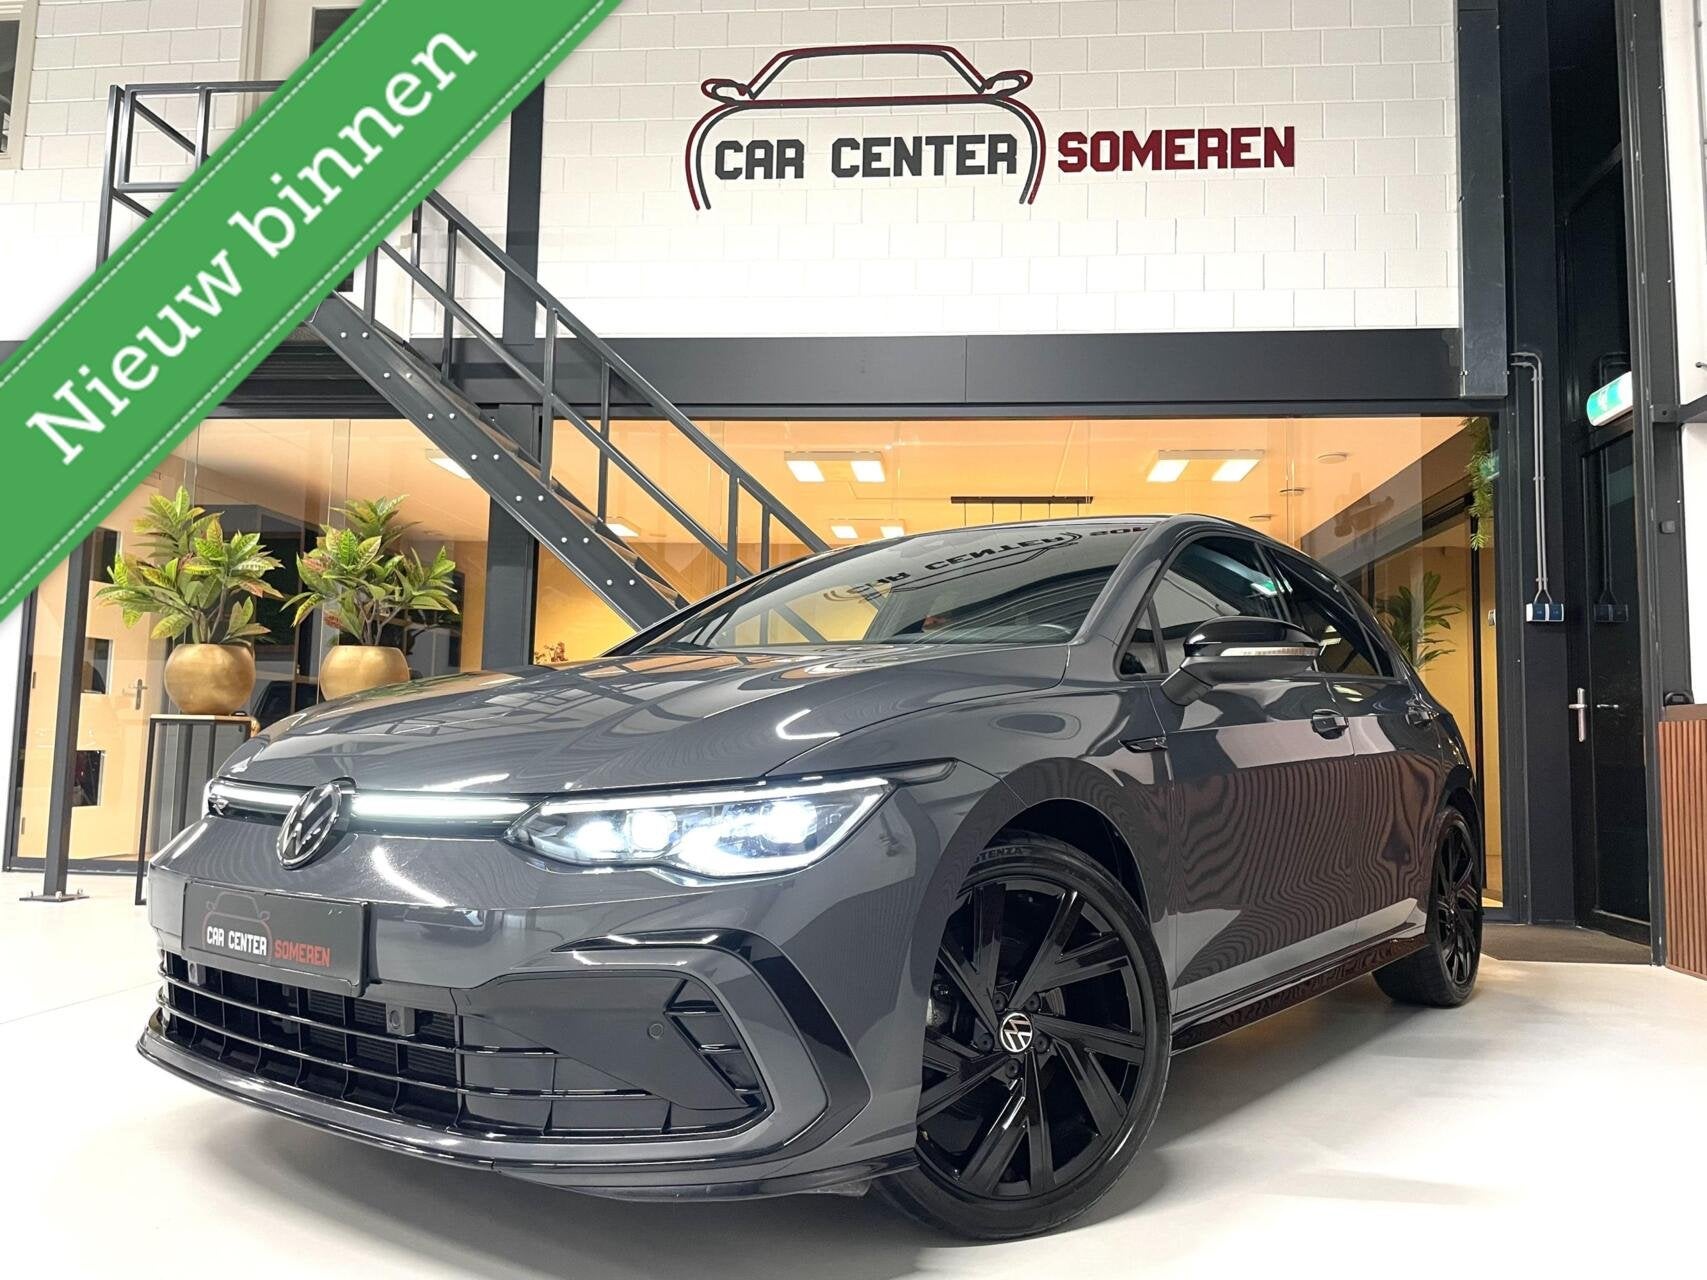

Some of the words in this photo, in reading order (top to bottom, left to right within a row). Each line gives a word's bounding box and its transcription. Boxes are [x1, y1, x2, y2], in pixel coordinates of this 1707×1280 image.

[714, 138, 805, 180] CAR
[831, 133, 1018, 178] CENTER
[1058, 126, 1295, 173] SOMEREN
[206, 925, 225, 948] CAR
[228, 930, 268, 956] CENTER
[274, 939, 330, 968] SOMEREN
